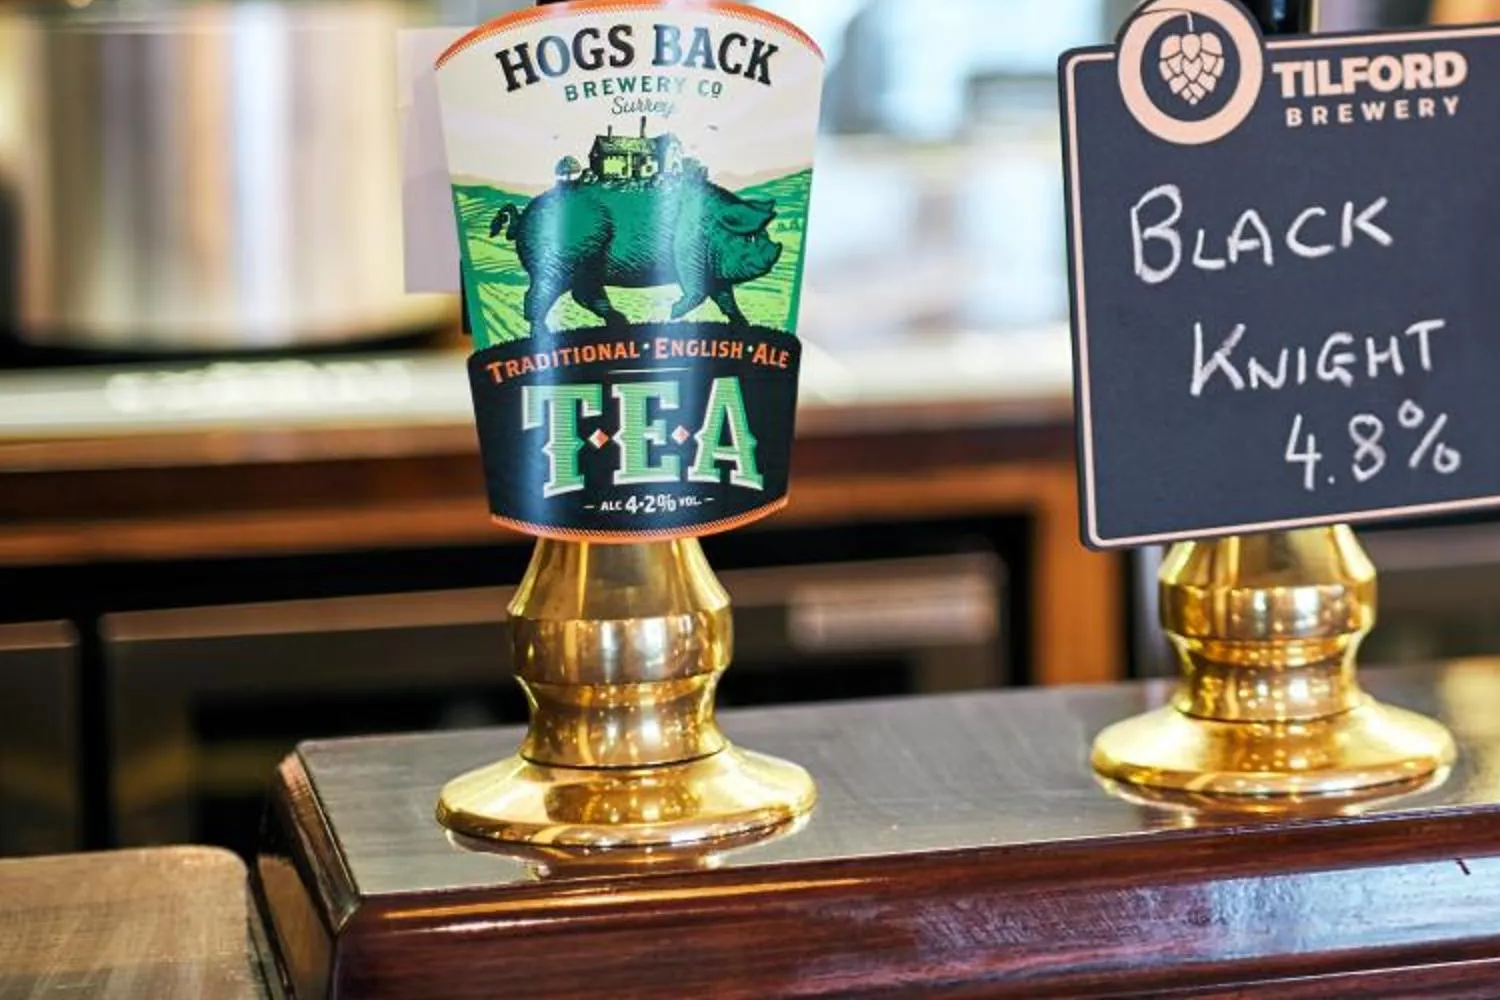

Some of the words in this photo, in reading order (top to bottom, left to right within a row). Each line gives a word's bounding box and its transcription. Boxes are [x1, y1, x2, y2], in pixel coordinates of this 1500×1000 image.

[495, 24, 634, 92] HOGS
[651, 22, 780, 86] BACK
[1272, 51, 1468, 98] TILFORD
[565, 76, 686, 102] BREWERY
[610, 96, 674, 118] Surrey
[1285, 96, 1461, 127] BREWERY
[1130, 184, 1393, 283] BLACK
[1190, 319, 1446, 396] KNIGHT
[1285, 400, 1462, 491] 4.8%
[600, 500, 623, 512] ALC
